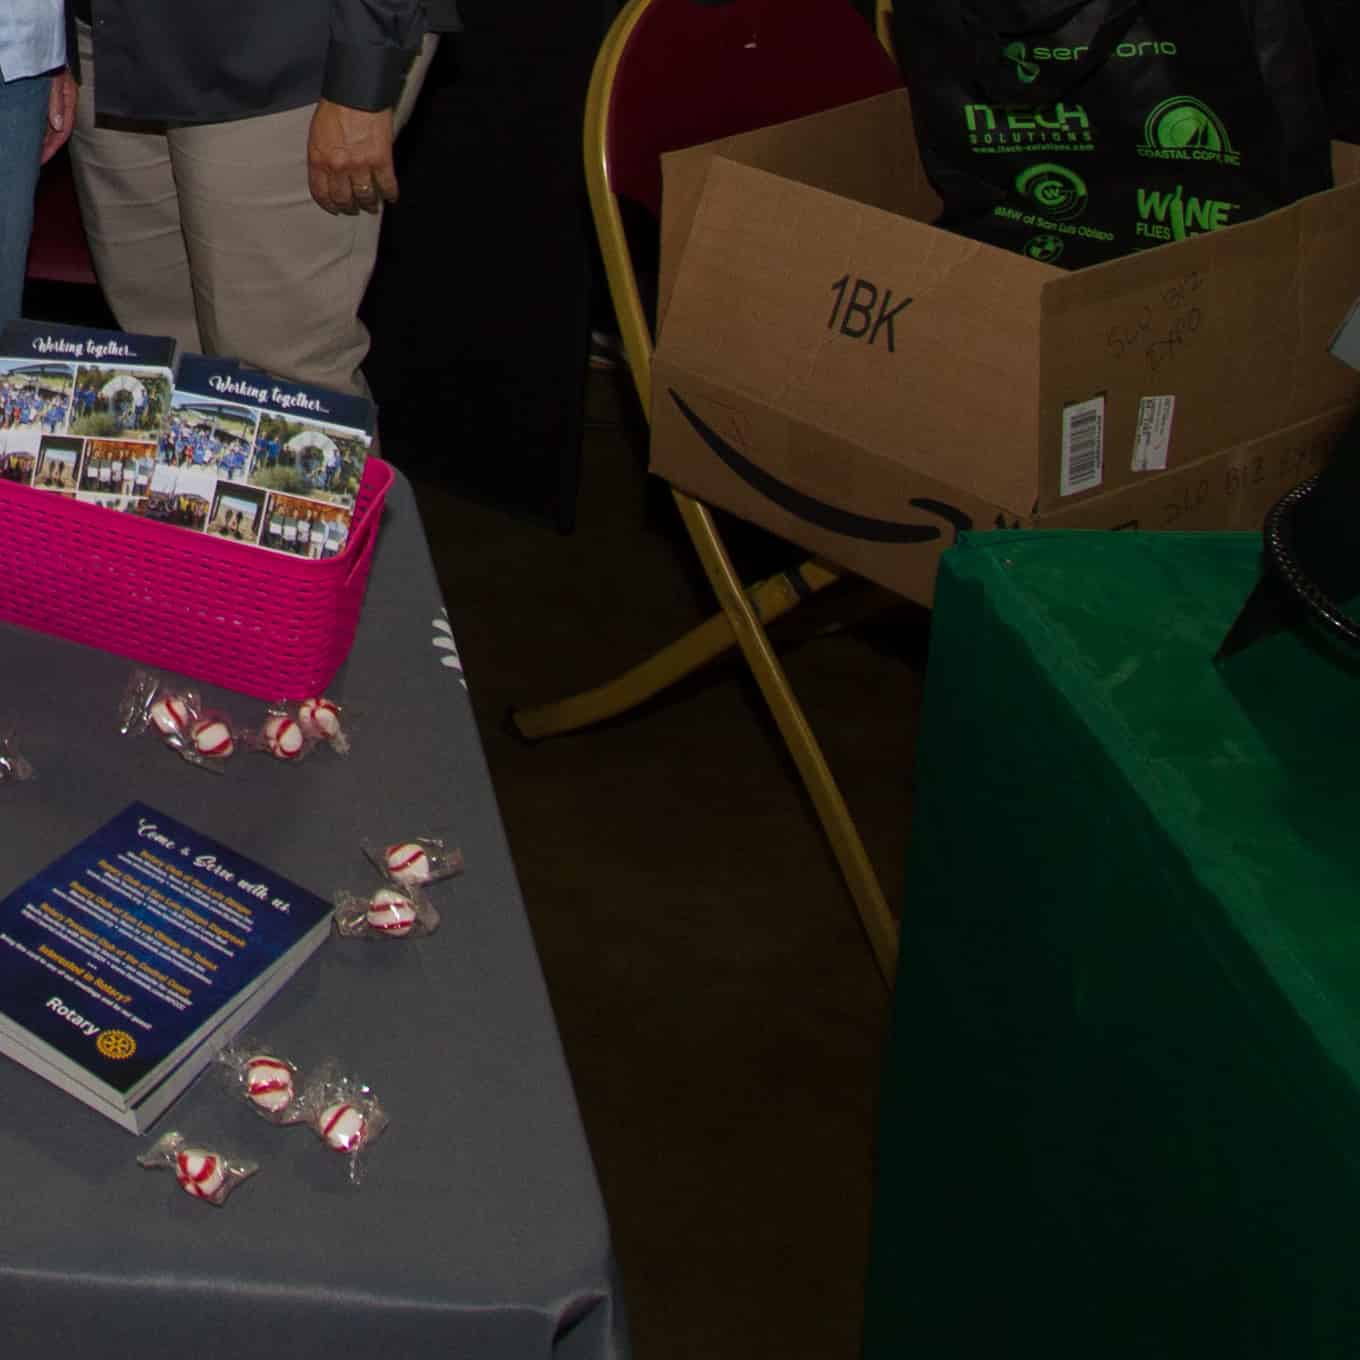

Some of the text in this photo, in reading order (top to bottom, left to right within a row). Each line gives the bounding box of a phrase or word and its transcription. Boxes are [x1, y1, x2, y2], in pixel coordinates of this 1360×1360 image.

[969, 131, 1092, 145] SOLUTIONS
[1024, 214, 1036, 226] of
[1037, 216, 1058, 231] San
[1136, 225, 1171, 241] FLIES
[827, 274, 913, 353] 1BK
[32, 336, 85, 357] Working
[209, 375, 269, 406] Working
[137, 817, 176, 849] Come
[192, 855, 235, 882] Serve
[236, 878, 269, 902] with
[45, 995, 101, 1036] Rotary
